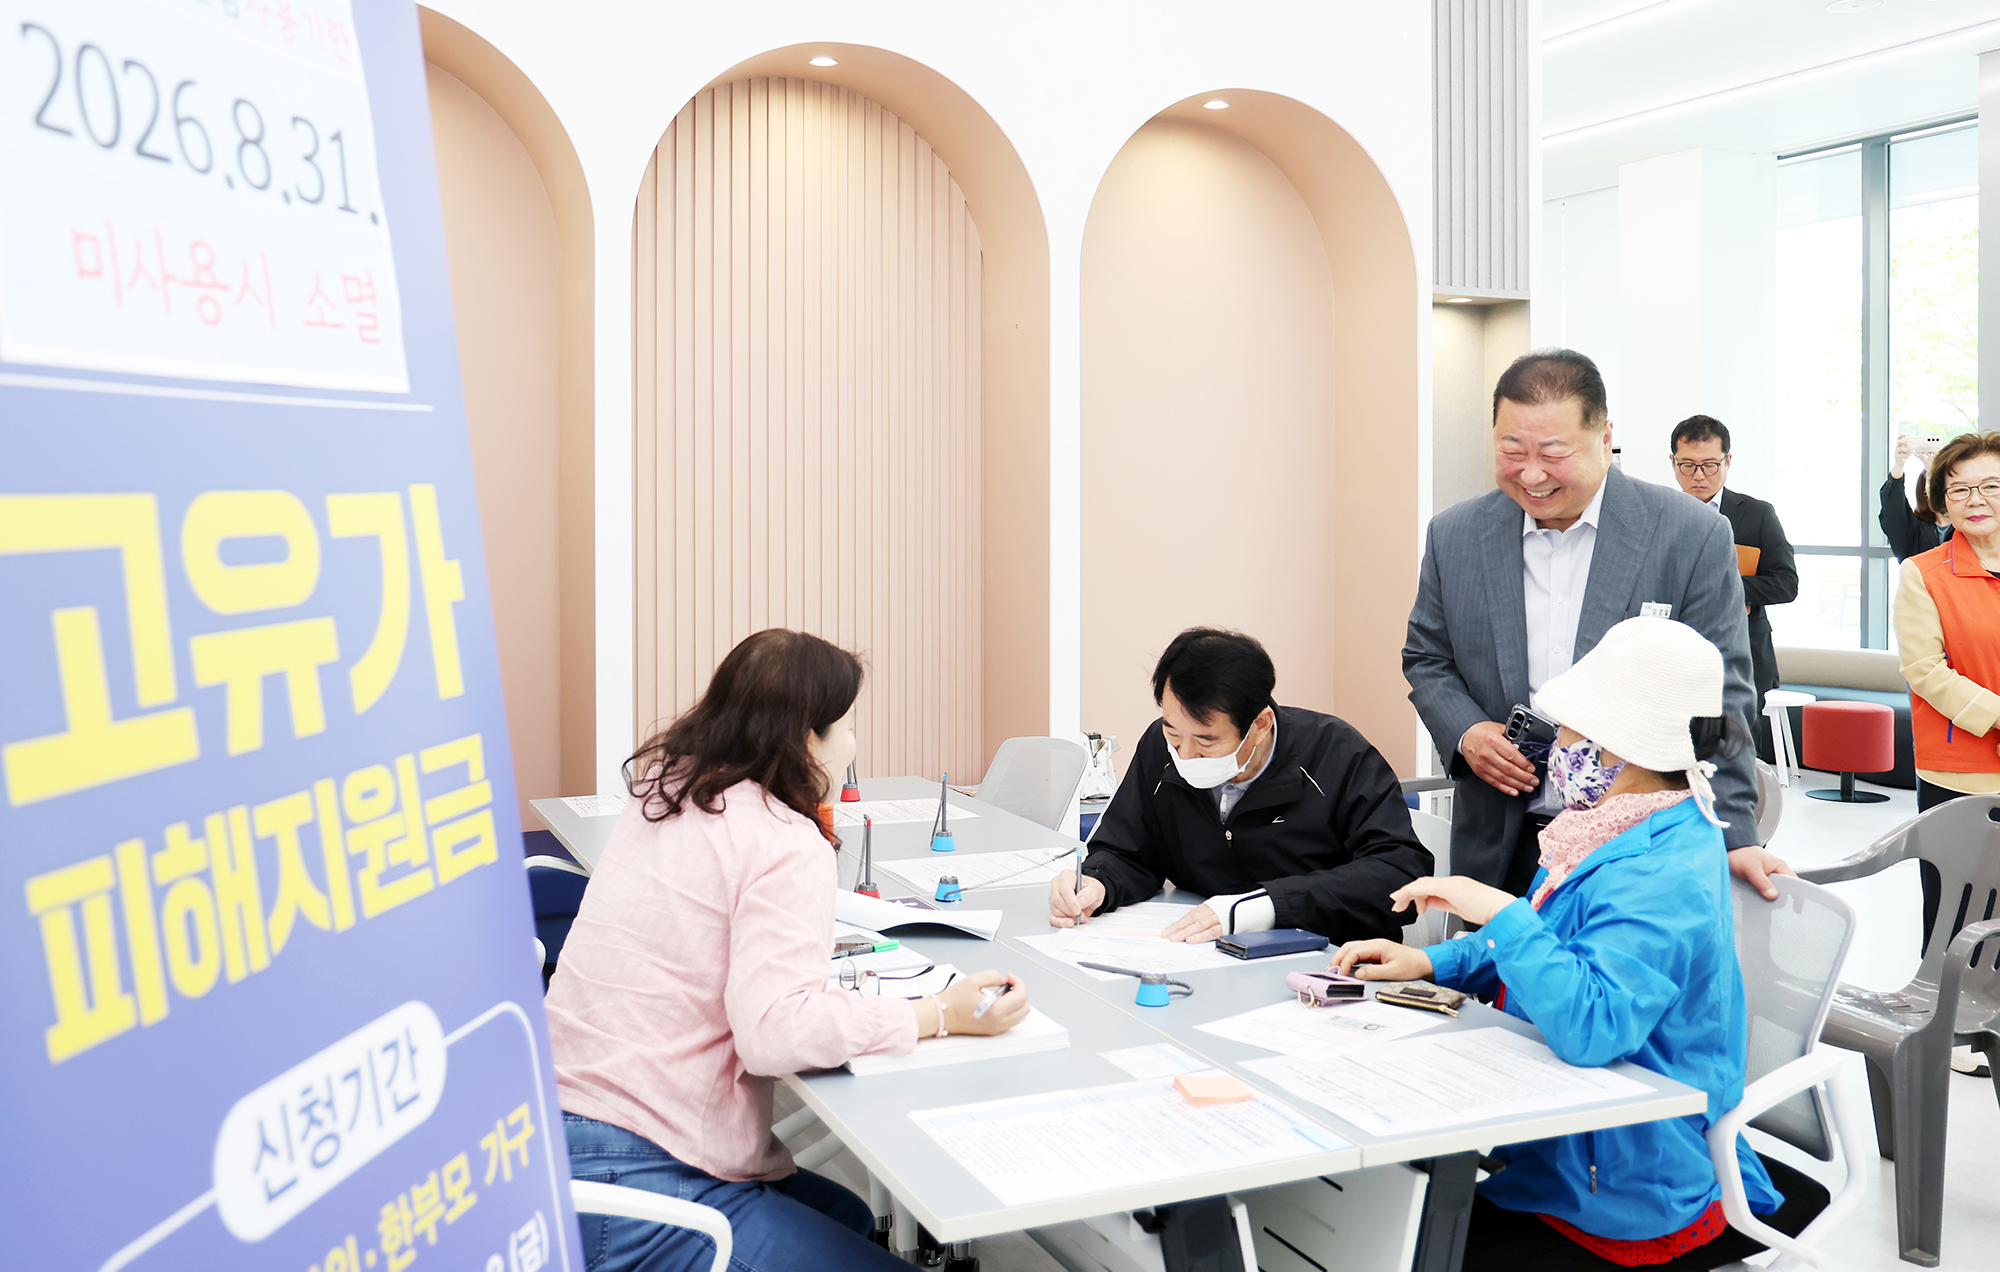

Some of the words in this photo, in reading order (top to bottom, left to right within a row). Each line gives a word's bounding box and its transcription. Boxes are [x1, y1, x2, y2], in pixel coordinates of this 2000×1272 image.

[20, 22, 380, 226] 2026.8.31.
[70, 217, 276, 329] 미사용시
[303, 271, 382, 345] 소멸
[0, 484, 465, 806] 고유가
[25, 733, 499, 1065] 피해지원금
[251, 1026, 421, 1204] 신청기간
[479, 1102, 535, 1186] 가구
